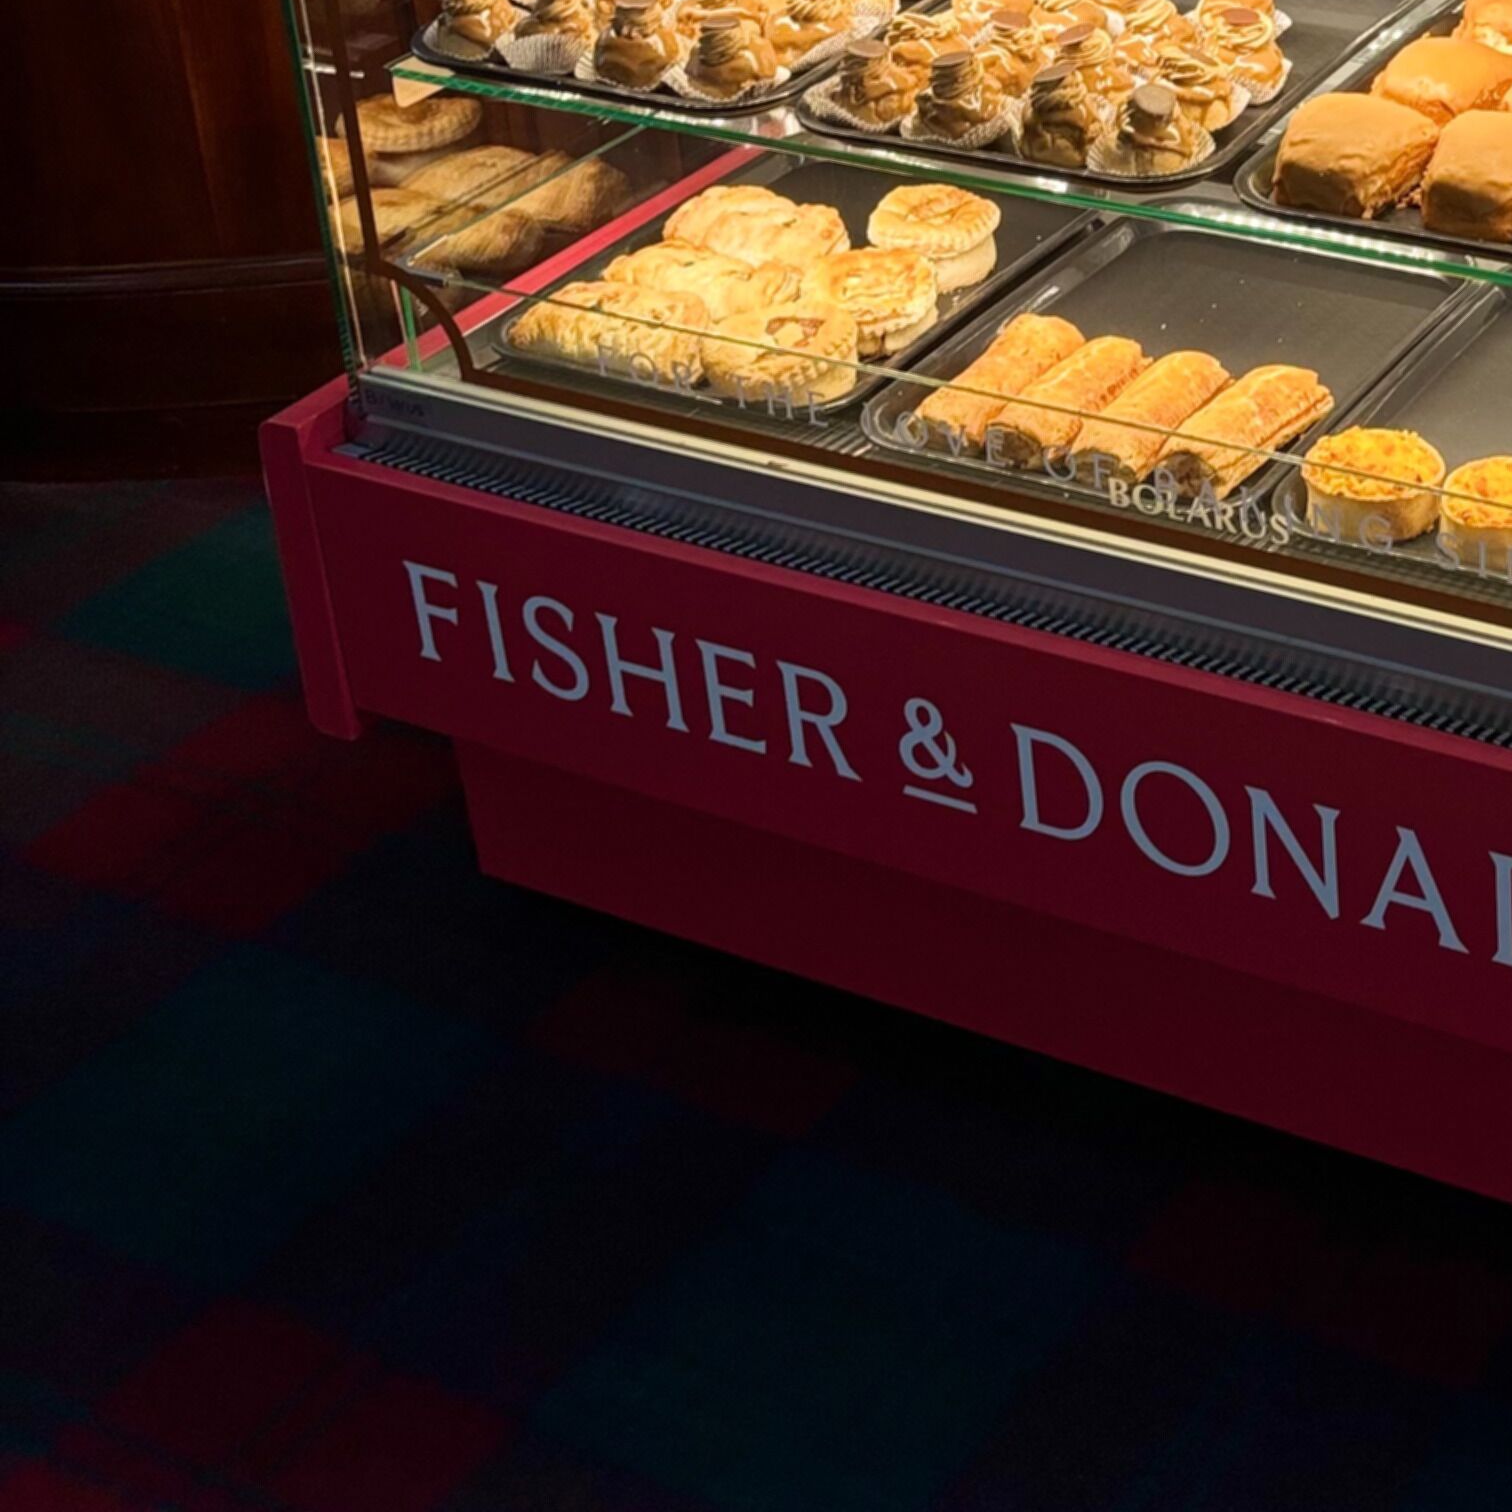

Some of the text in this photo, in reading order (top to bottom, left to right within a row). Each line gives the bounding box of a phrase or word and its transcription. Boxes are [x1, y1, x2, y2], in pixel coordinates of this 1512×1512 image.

[598, 344, 701, 394] FOR
[734, 374, 831, 430] THE
[863, 401, 1015, 466] LOVE
[1043, 441, 1113, 489] OF
[1153, 467, 1394, 554] BAKING
[1108, 476, 1290, 545] BOLARUS
[402, 560, 862, 782] FISHER
[899, 696, 979, 815] &
